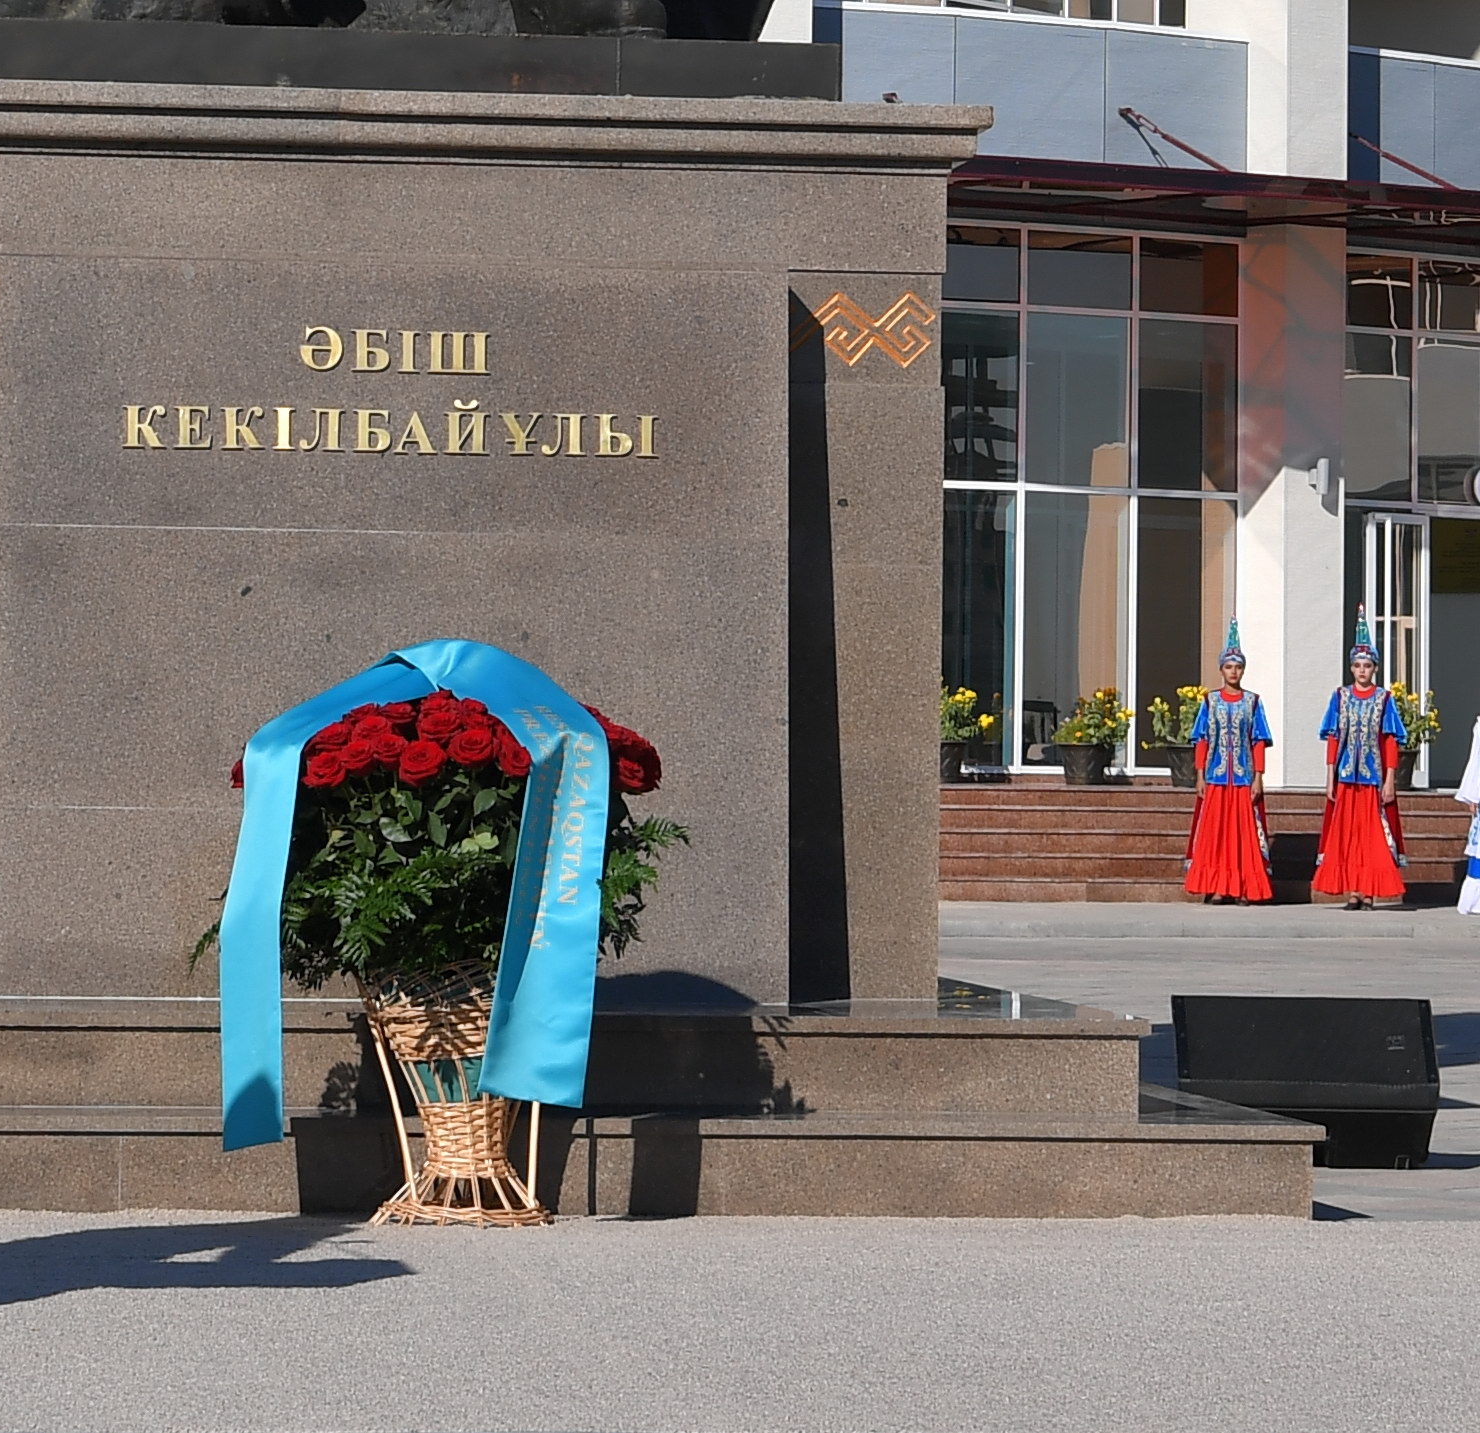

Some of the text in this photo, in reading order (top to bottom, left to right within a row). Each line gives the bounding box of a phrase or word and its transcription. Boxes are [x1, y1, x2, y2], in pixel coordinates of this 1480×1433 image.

[299, 325, 492, 375] ӘБІШ
[122, 399, 659, 458] КЕКІЛБАЙҰЛЫ
[557, 731, 595, 907] QAZAQSTAN
